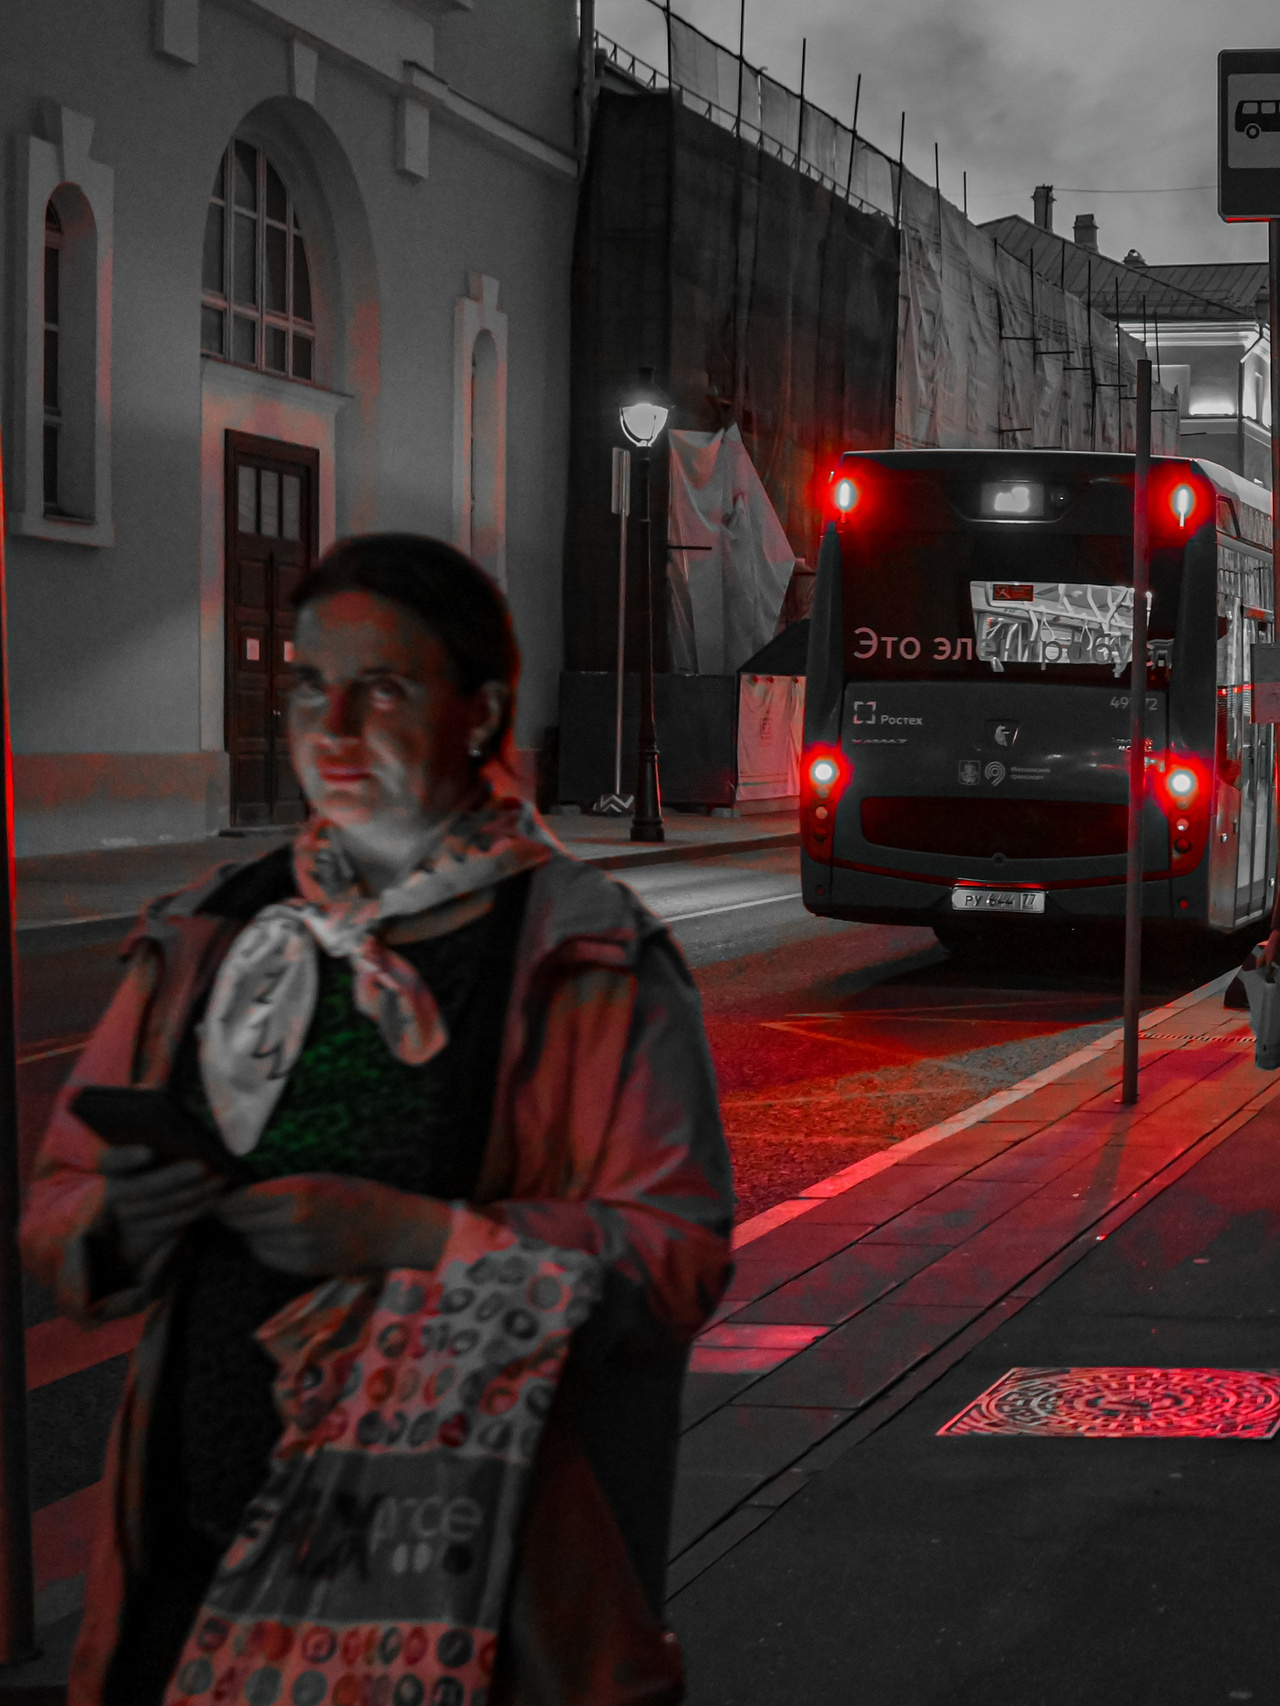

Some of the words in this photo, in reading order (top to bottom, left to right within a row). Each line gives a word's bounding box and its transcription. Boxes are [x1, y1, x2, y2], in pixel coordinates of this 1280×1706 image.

[852, 626, 921, 661] Это
[932, 633, 1154, 671] электробу
[880, 714, 924, 726] Ростех
